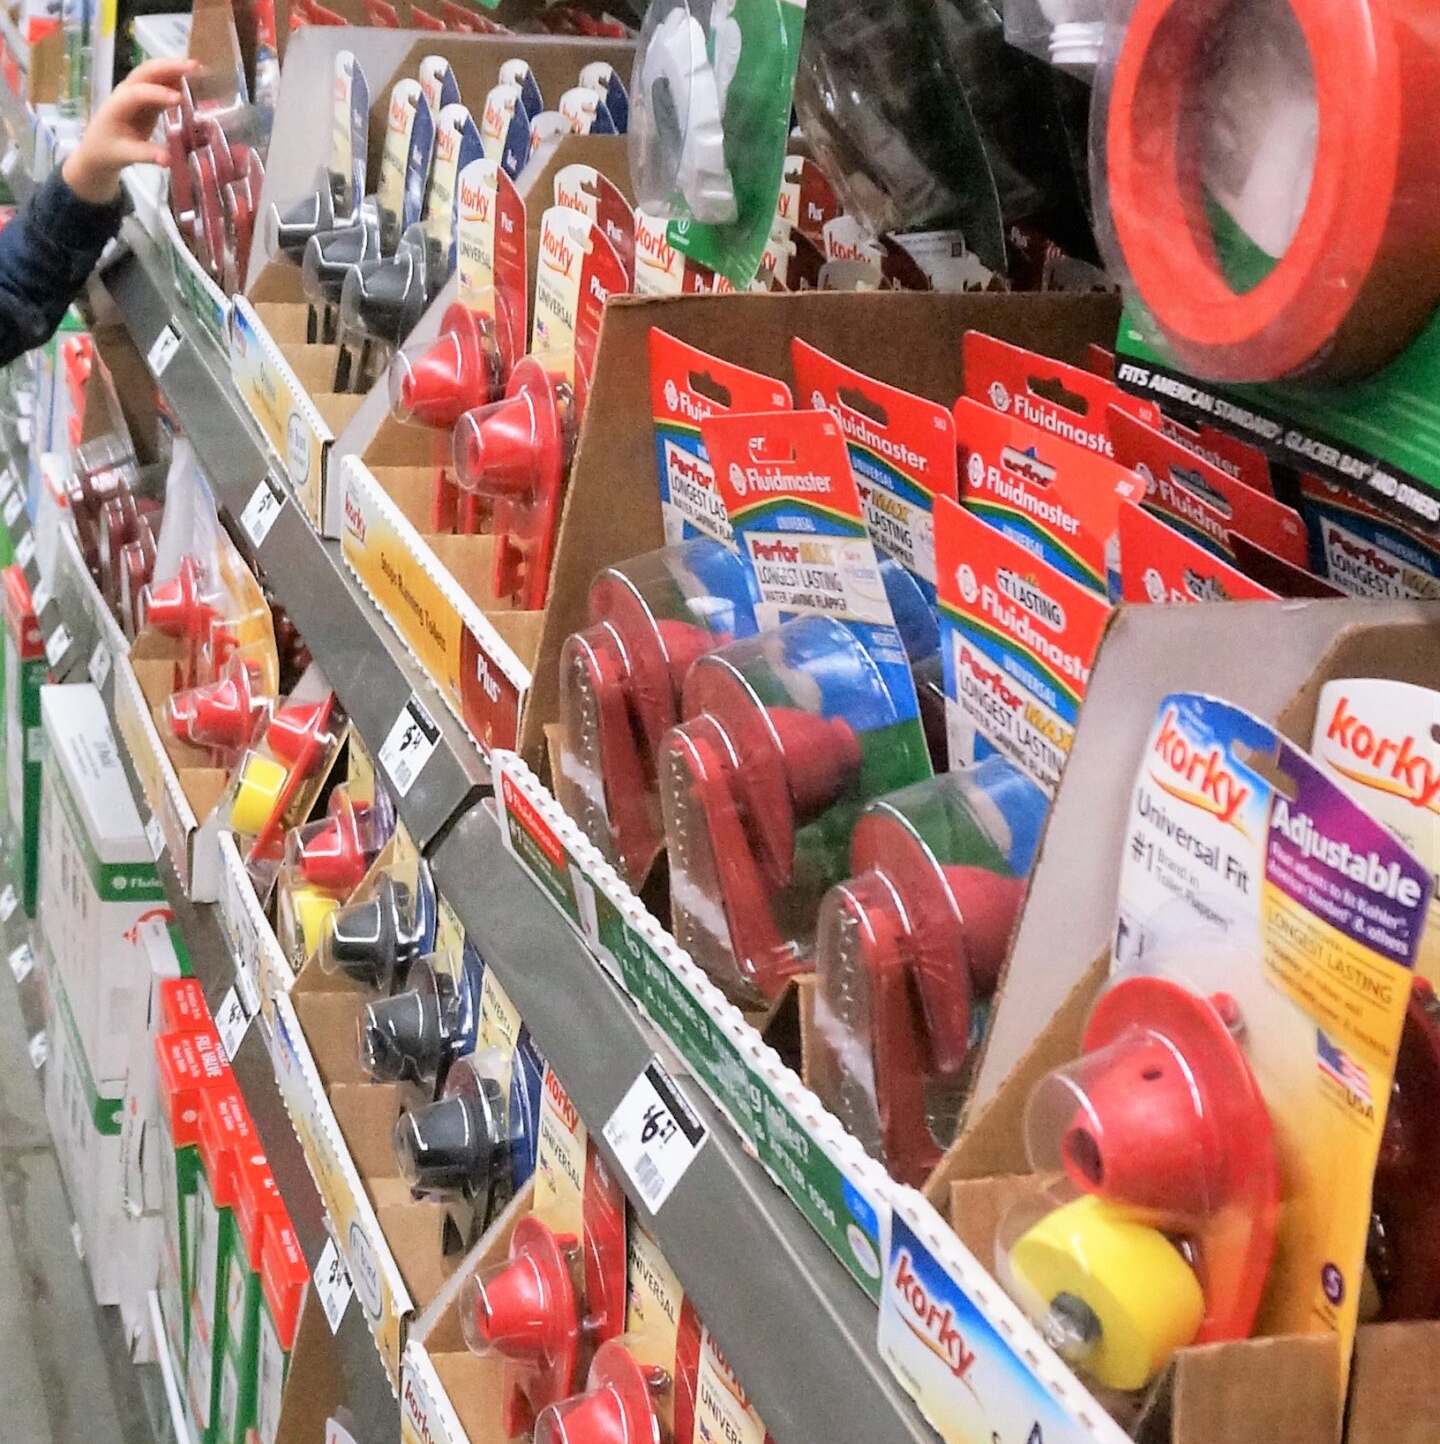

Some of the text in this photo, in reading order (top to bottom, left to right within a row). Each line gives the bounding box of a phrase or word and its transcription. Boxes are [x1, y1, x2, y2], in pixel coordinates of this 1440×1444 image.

[461, 182, 489, 221] korky
[460, 241, 491, 270] UNIVERSAL
[543, 221, 573, 275] korky
[635, 217, 676, 273] korky
[539, 286, 572, 330] UNIVERSAL
[591, 276, 608, 303] Plus
[1119, 363, 1150, 387] FITS
[1150, 374, 1213, 411] AMERICAN
[1284, 431, 1340, 466] GLACIER
[1368, 470, 1397, 497] AND
[671, 475, 707, 508] LONGEST
[747, 468, 832, 492] Fluidmaster
[987, 466, 1080, 535] Fluidmaster
[777, 517, 816, 531] UNIVERSAL
[869, 509, 913, 548] LASTING
[380, 552, 446, 652] Stops Running Toilets
[760, 565, 842, 593] LONGEST LASTING
[765, 591, 785, 604] WATER
[810, 595, 847, 610] FLAPPER
[1012, 581, 1061, 627] LASTING
[477, 654, 501, 703] Plus
[960, 674, 1013, 729] LONGEST
[1004, 657, 1057, 709] UNIVERSAL
[1154, 709, 1246, 822] korky
[1327, 698, 1440, 806] korky
[1131, 832, 1154, 873] #1
[1138, 788, 1248, 894] Universal Fit
[1157, 847, 1186, 883] Brand
[1273, 800, 1421, 908] Adjustable
[1352, 915, 1365, 934] &
[1366, 924, 1409, 956] others
[1328, 951, 1394, 1004] LASTING
[201, 1052, 223, 1078] VALVE
[545, 1061, 578, 1135] korky
[541, 1124, 581, 1193] UNIVERSAL
[896, 1256, 975, 1379] korky
